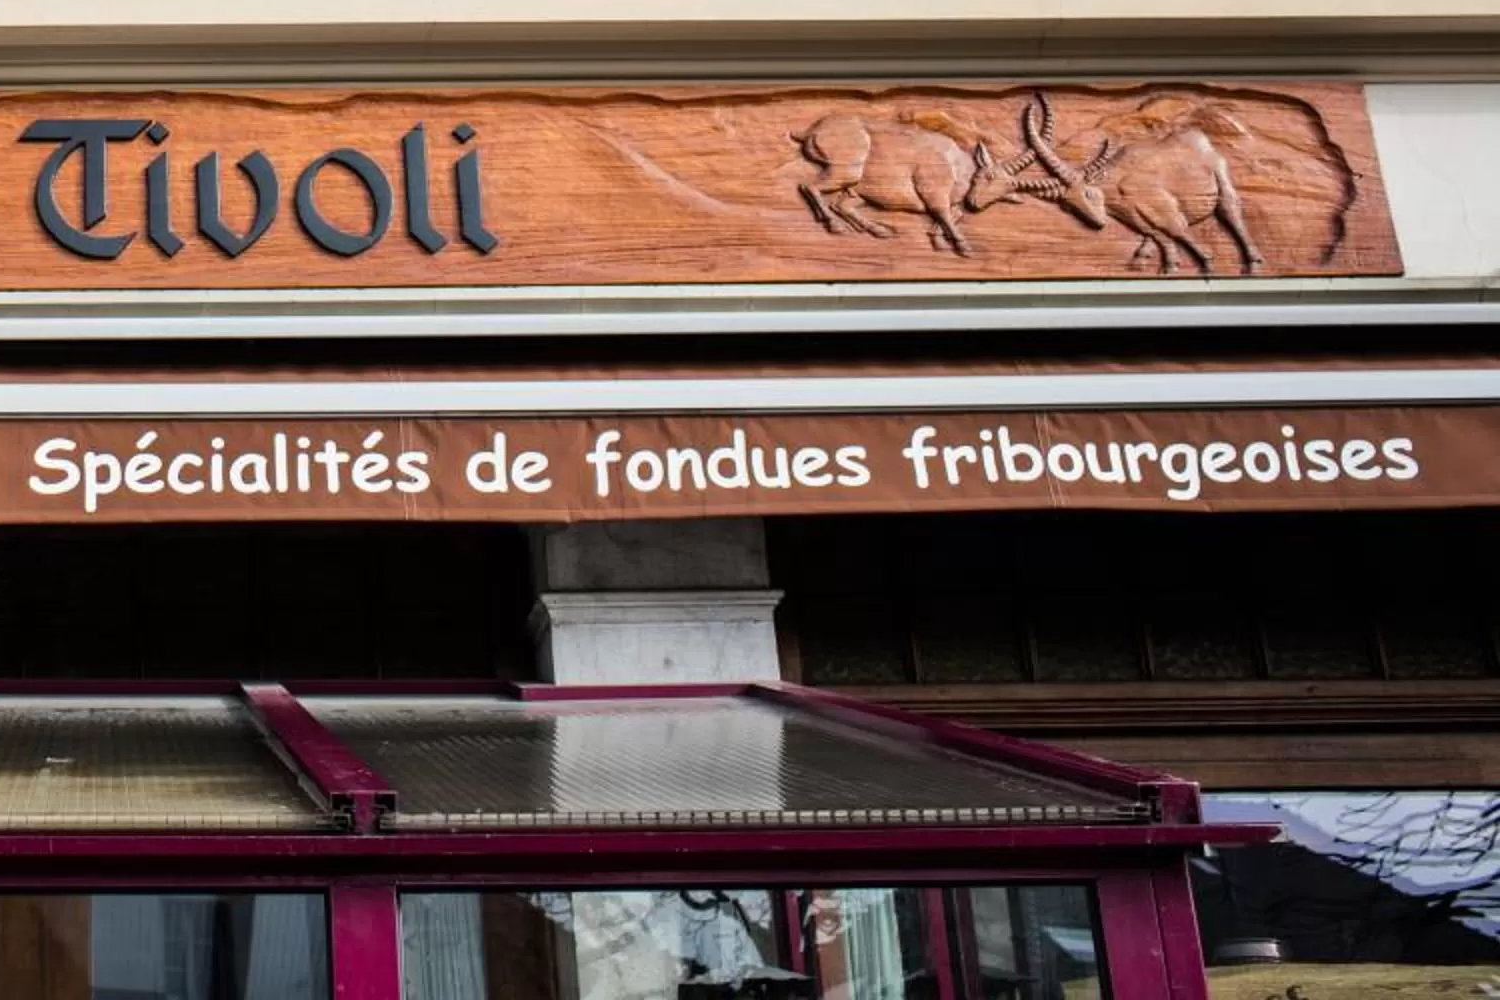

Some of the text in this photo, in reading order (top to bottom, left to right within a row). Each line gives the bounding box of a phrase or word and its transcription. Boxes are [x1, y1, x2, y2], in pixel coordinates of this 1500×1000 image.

[21, 118, 499, 260] Tivoli
[27, 424, 1420, 514] Spécialités de fondues fribourgeoises
